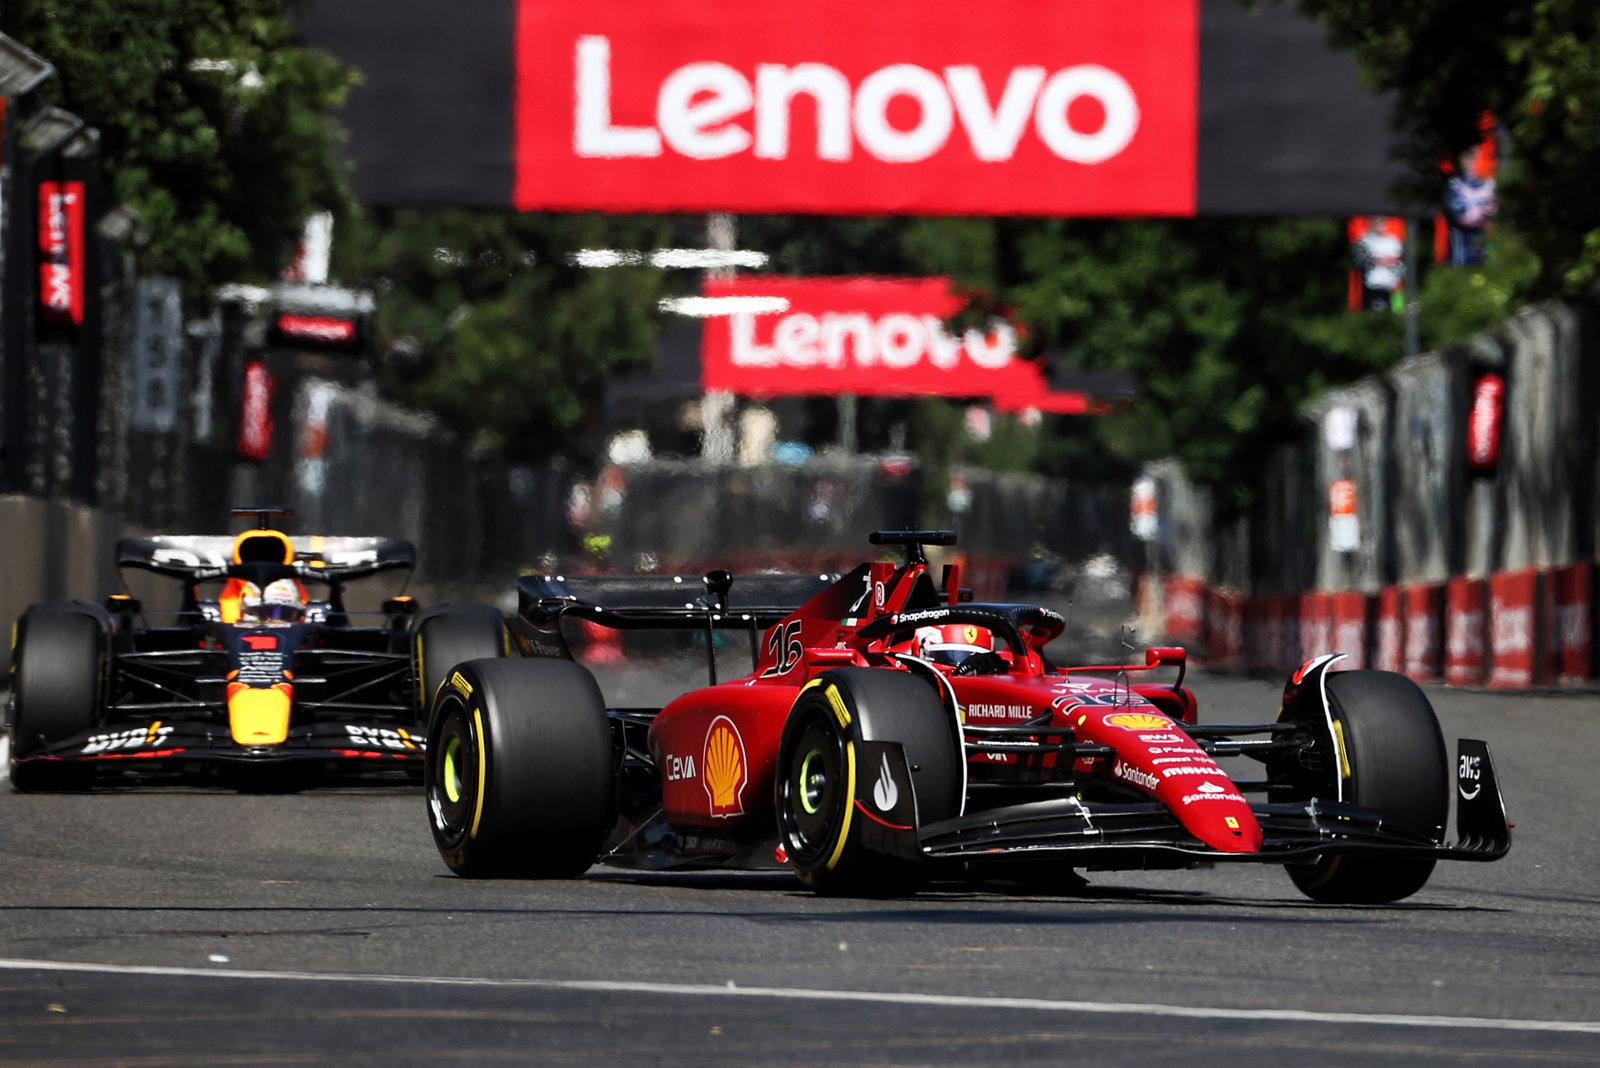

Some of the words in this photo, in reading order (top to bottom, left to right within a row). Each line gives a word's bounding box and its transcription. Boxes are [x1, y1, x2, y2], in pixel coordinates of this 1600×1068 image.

[573, 34, 1140, 164] Lenovo
[899, 608, 950, 624] Snapdragon
[758, 619, 804, 679] 16
[968, 703, 1006, 718] RICHARD
[1007, 705, 1033, 719] MILLE
[1122, 762, 1161, 790] Santander
